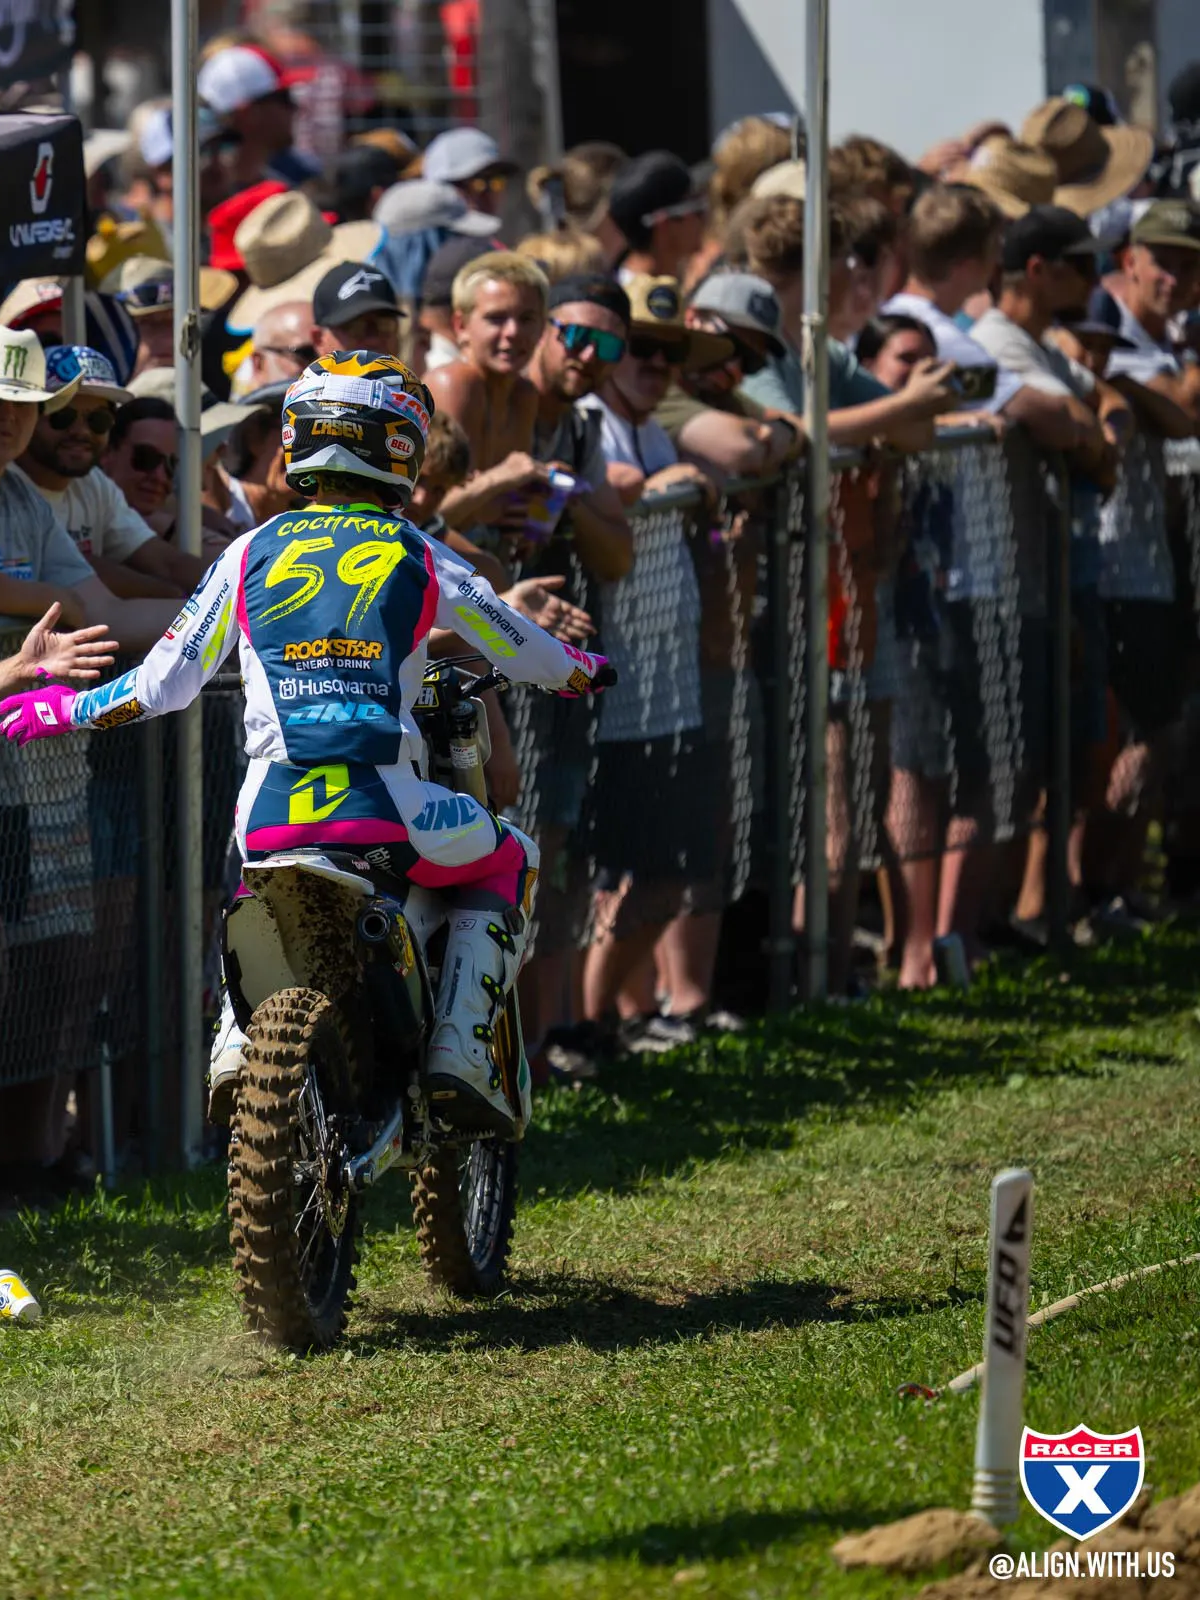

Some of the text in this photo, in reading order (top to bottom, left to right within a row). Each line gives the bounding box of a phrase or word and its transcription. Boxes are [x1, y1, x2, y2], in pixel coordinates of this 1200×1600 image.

[311, 418, 364, 440] CASEY
[391, 438, 411, 453] BELL
[276, 515, 402, 538] COCHRAN
[257, 536, 408, 632] 59
[189, 579, 230, 648] Husqvarna
[469, 589, 528, 647] Husqvarna
[284, 638, 383, 661] ROCKSTAR
[295, 657, 372, 672] ENERGY DRINK
[298, 678, 390, 696] Husqvarna
